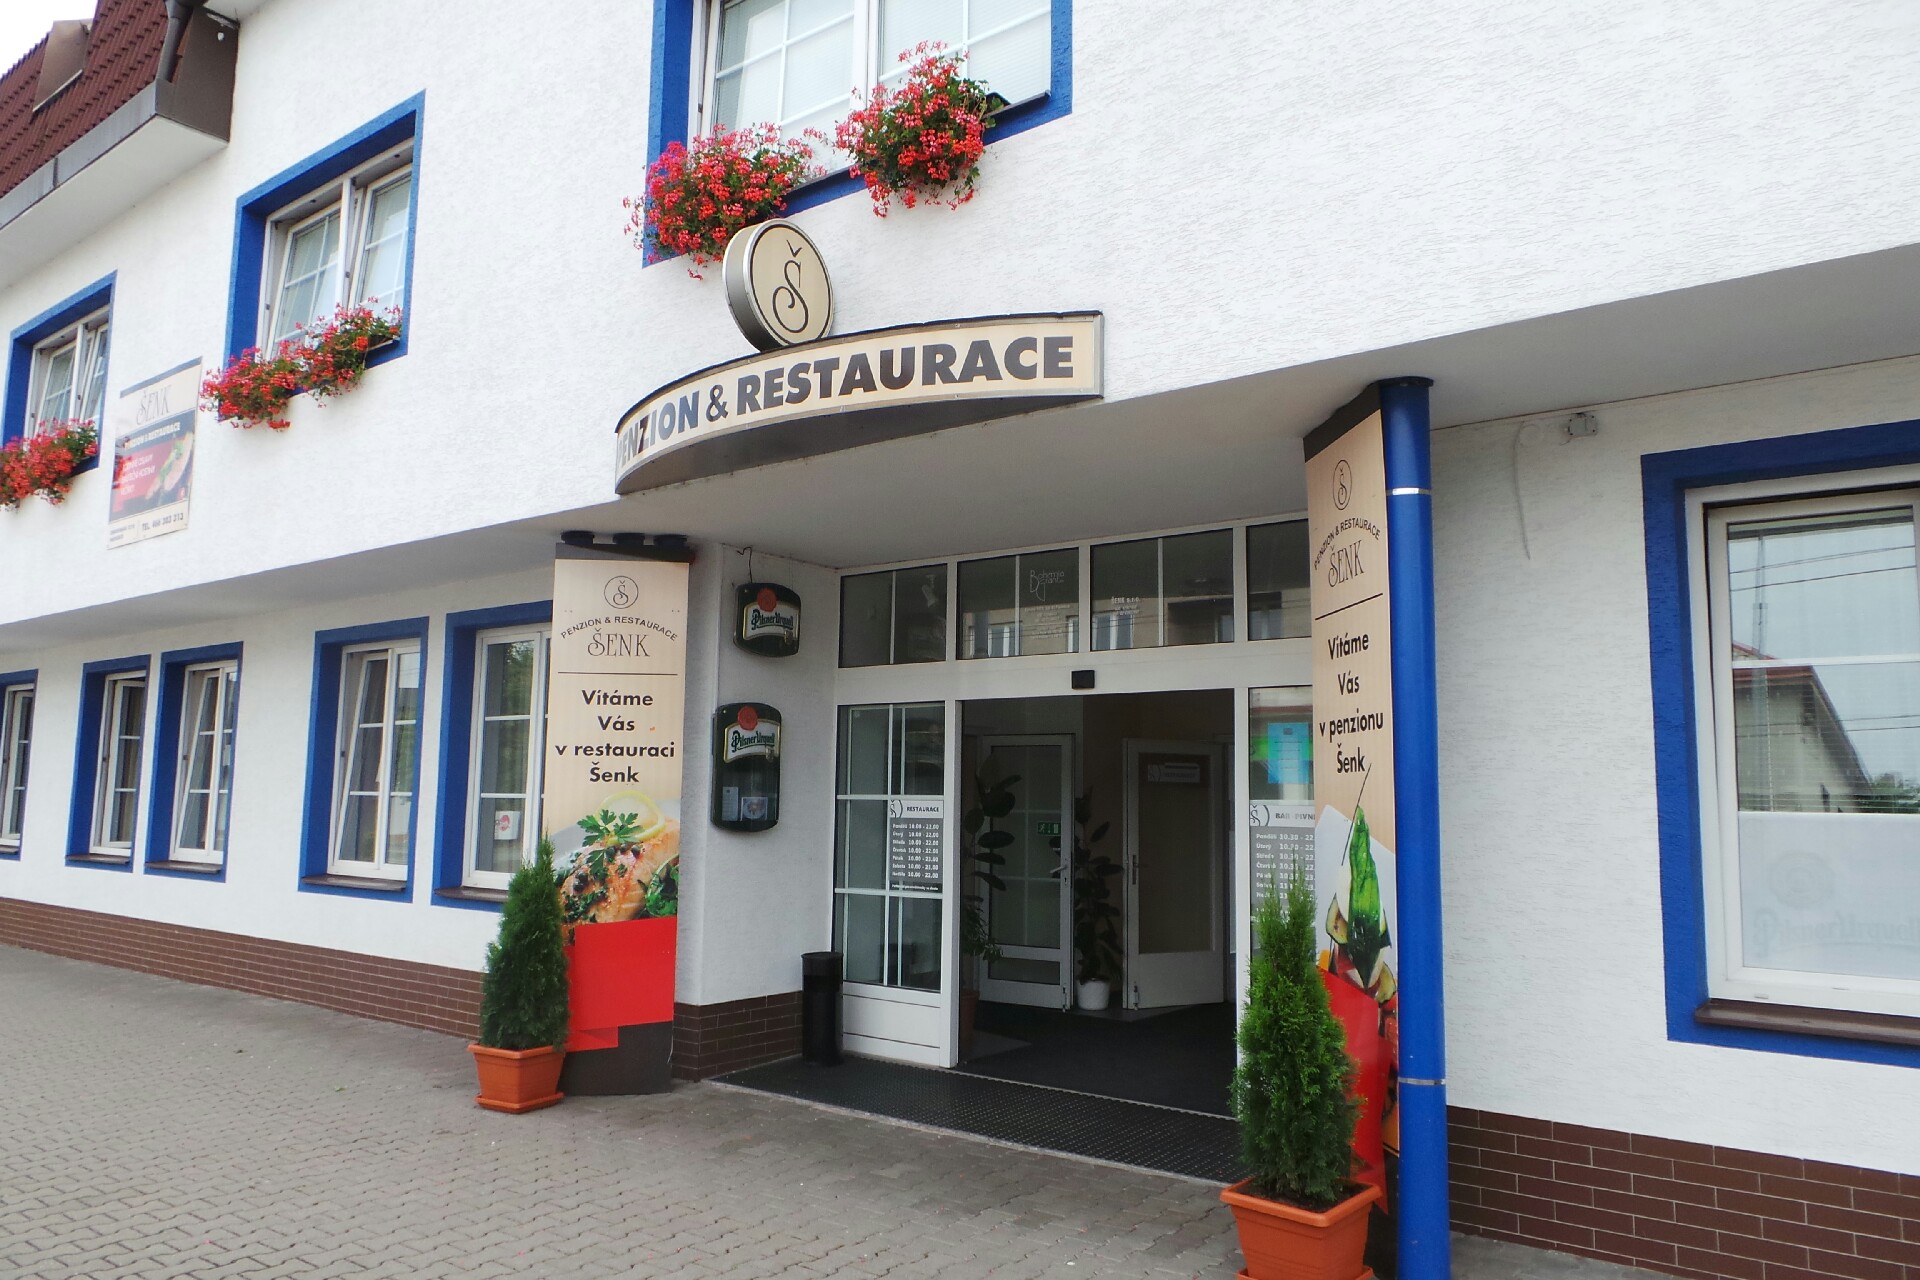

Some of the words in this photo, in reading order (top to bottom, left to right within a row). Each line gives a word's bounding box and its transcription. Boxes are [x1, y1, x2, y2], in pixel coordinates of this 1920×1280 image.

[705, 385, 728, 423] &
[737, 336, 1074, 416] RESTAURACE
[1314, 529, 1335, 570] PENZION
[1335, 526, 1340, 536] &
[1340, 517, 1380, 540] RESTAURACE
[1328, 540, 1364, 587] ŠENK
[560, 617, 602, 639] PENZION
[604, 616, 611, 624] &
[614, 616, 678, 642] RESTAURACE
[751, 608, 774, 630] Pilsner
[587, 627, 650, 657] ŠENK
[1327, 631, 1369, 660] Vítáme
[1338, 671, 1360, 696] Vás
[581, 689, 653, 706] Vítáme
[597, 715, 635, 731] Vás
[1319, 721, 1326, 737] v
[1329, 711, 1384, 744] penzionu
[555, 745, 567, 756] v
[574, 742, 675, 758] restauraci
[731, 730, 756, 753] Pilsner
[1336, 743, 1365, 774] Šenk
[589, 761, 639, 783] Šenk
